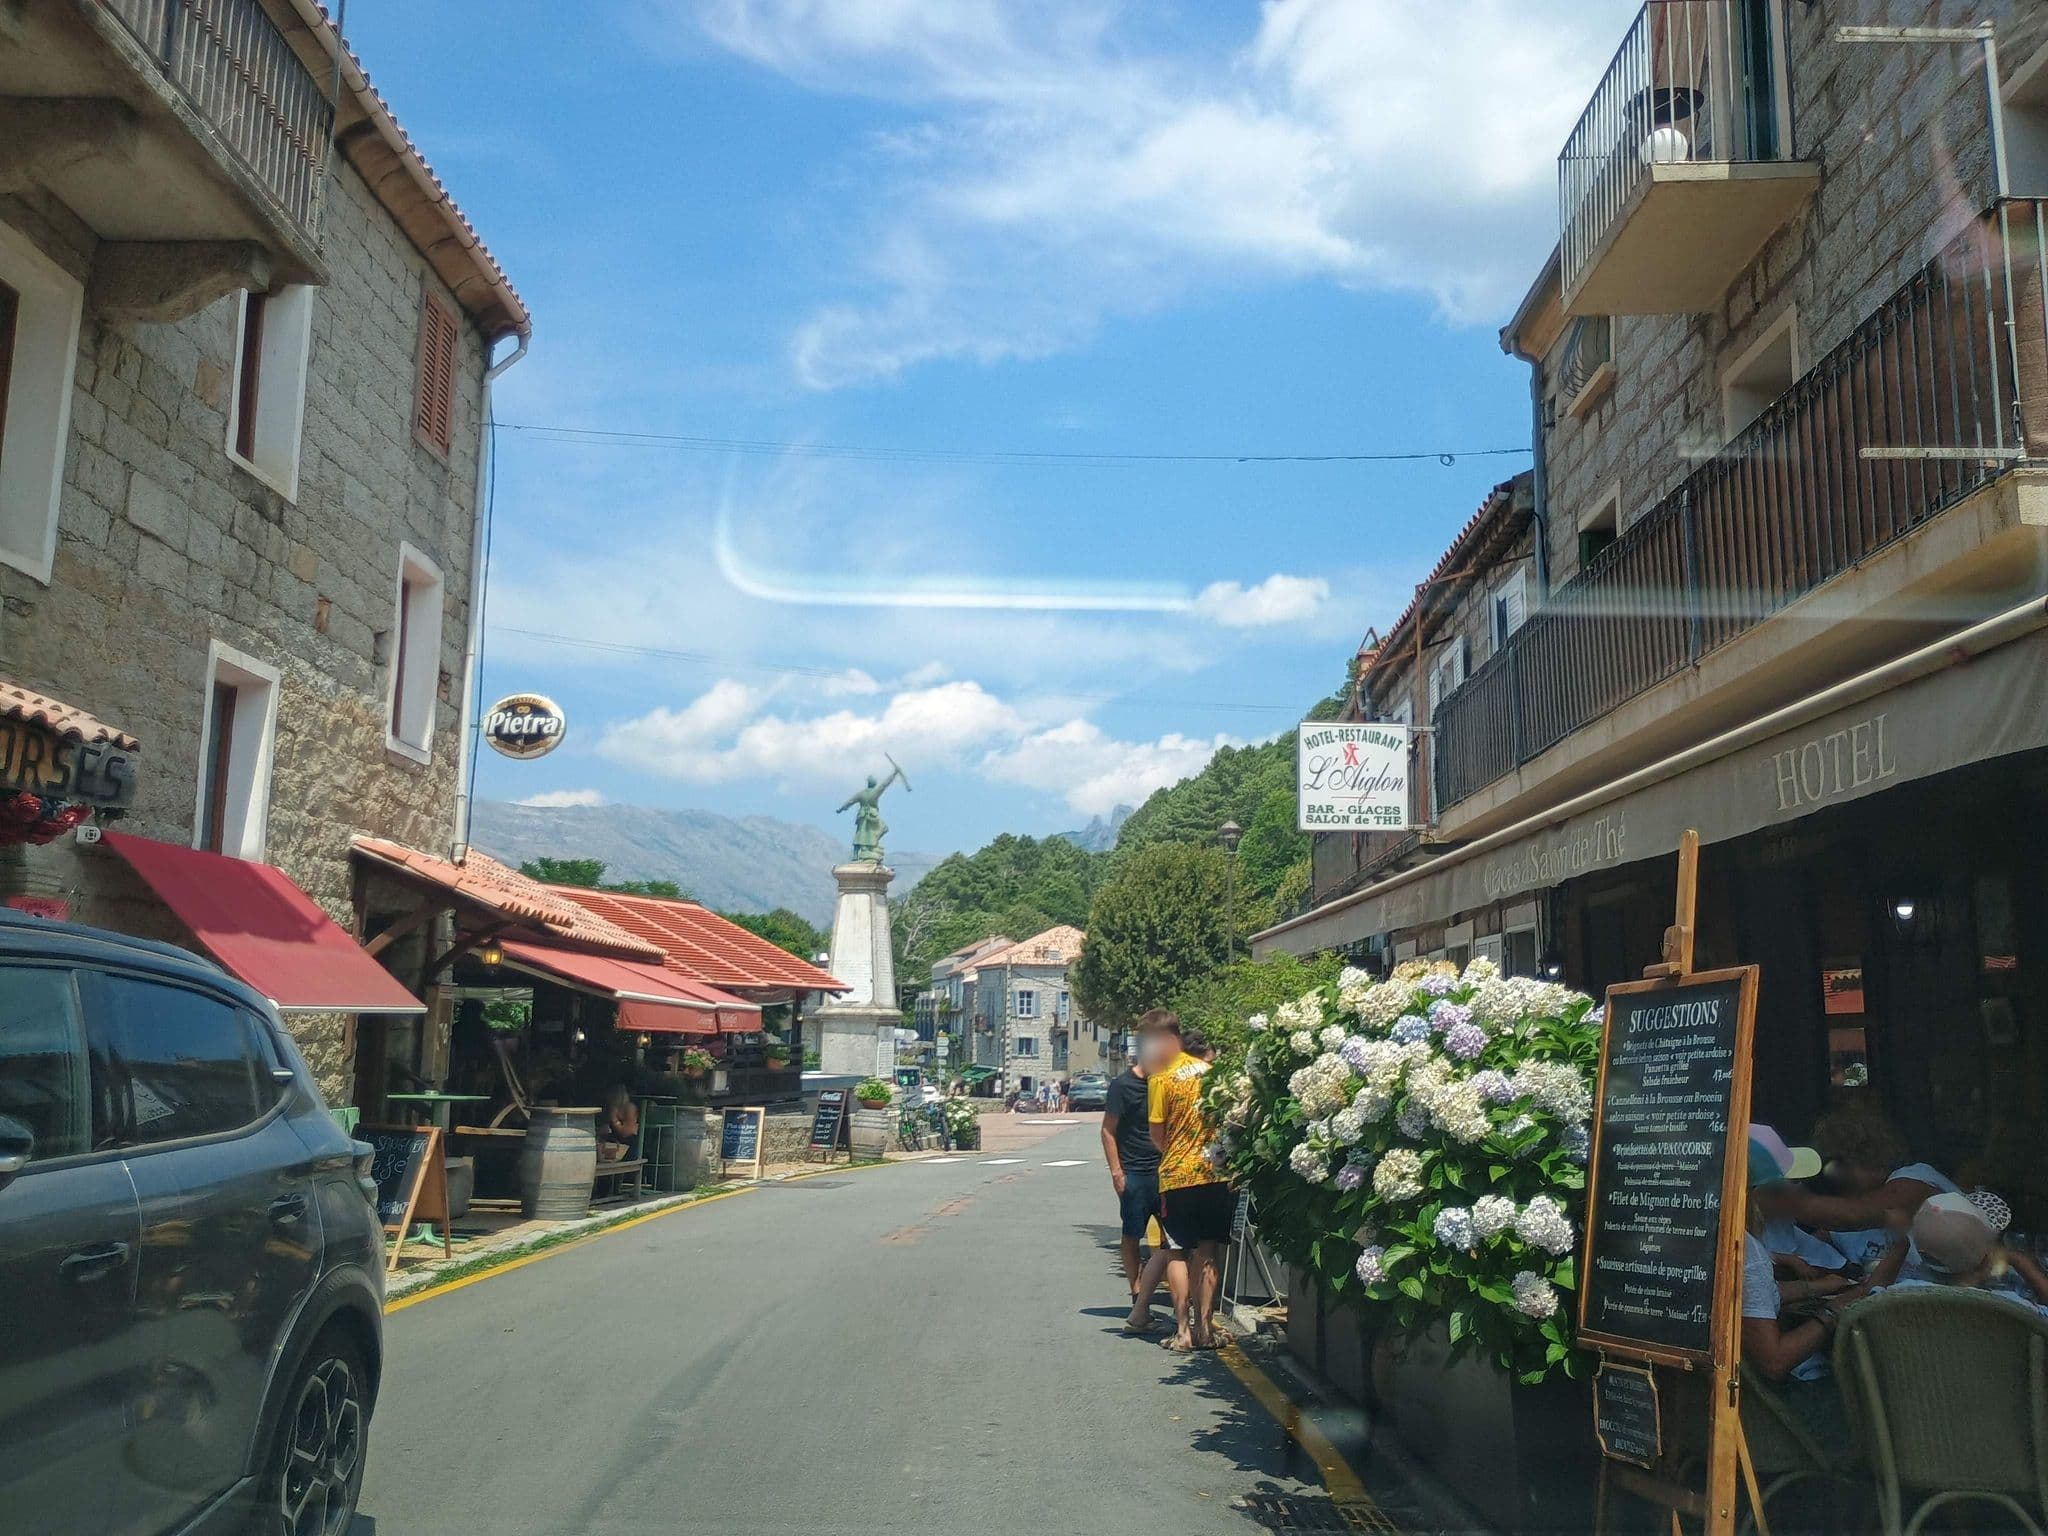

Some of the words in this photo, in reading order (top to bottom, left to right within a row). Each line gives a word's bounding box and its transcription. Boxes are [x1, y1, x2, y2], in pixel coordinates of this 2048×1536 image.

[487, 711, 562, 737] Pietra
[1304, 729, 1402, 751] HOTEL-RESTAURANT
[1772, 713, 1897, 811] HOTEL
[1303, 756, 1405, 804] L'Aiglon
[1306, 815, 1350, 824] SALON
[1355, 815, 1369, 824] de
[1374, 816, 1402, 825] THE
[1307, 804, 1334, 814] BAR
[1348, 805, 1401, 815] GLACES
[1570, 828, 1589, 870] de
[1594, 811, 1626, 863] Thé
[1629, 1000, 1719, 1033] SUGGESTIONS
[1705, 1047, 1727, 1058] ardoise
[1657, 1093, 1682, 1104] Brousse
[1651, 1110, 1666, 1120] voir
[1666, 1111, 1687, 1123] petite
[1688, 1108, 1714, 1120] ardoise
[1681, 1141, 1712, 1156] CORSE
[1612, 1191, 1629, 1205] Filet
[1630, 1192, 1639, 1206] de
[1640, 1192, 1669, 1211] Mignon
[1671, 1193, 1680, 1207] de
[1682, 1194, 1702, 1209] Porc
[1599, 1256, 1624, 1272] Saucisse
[1625, 1260, 1657, 1275] artisanale
[1658, 1260, 1666, 1276] de
[1667, 1266, 1682, 1281] porc
